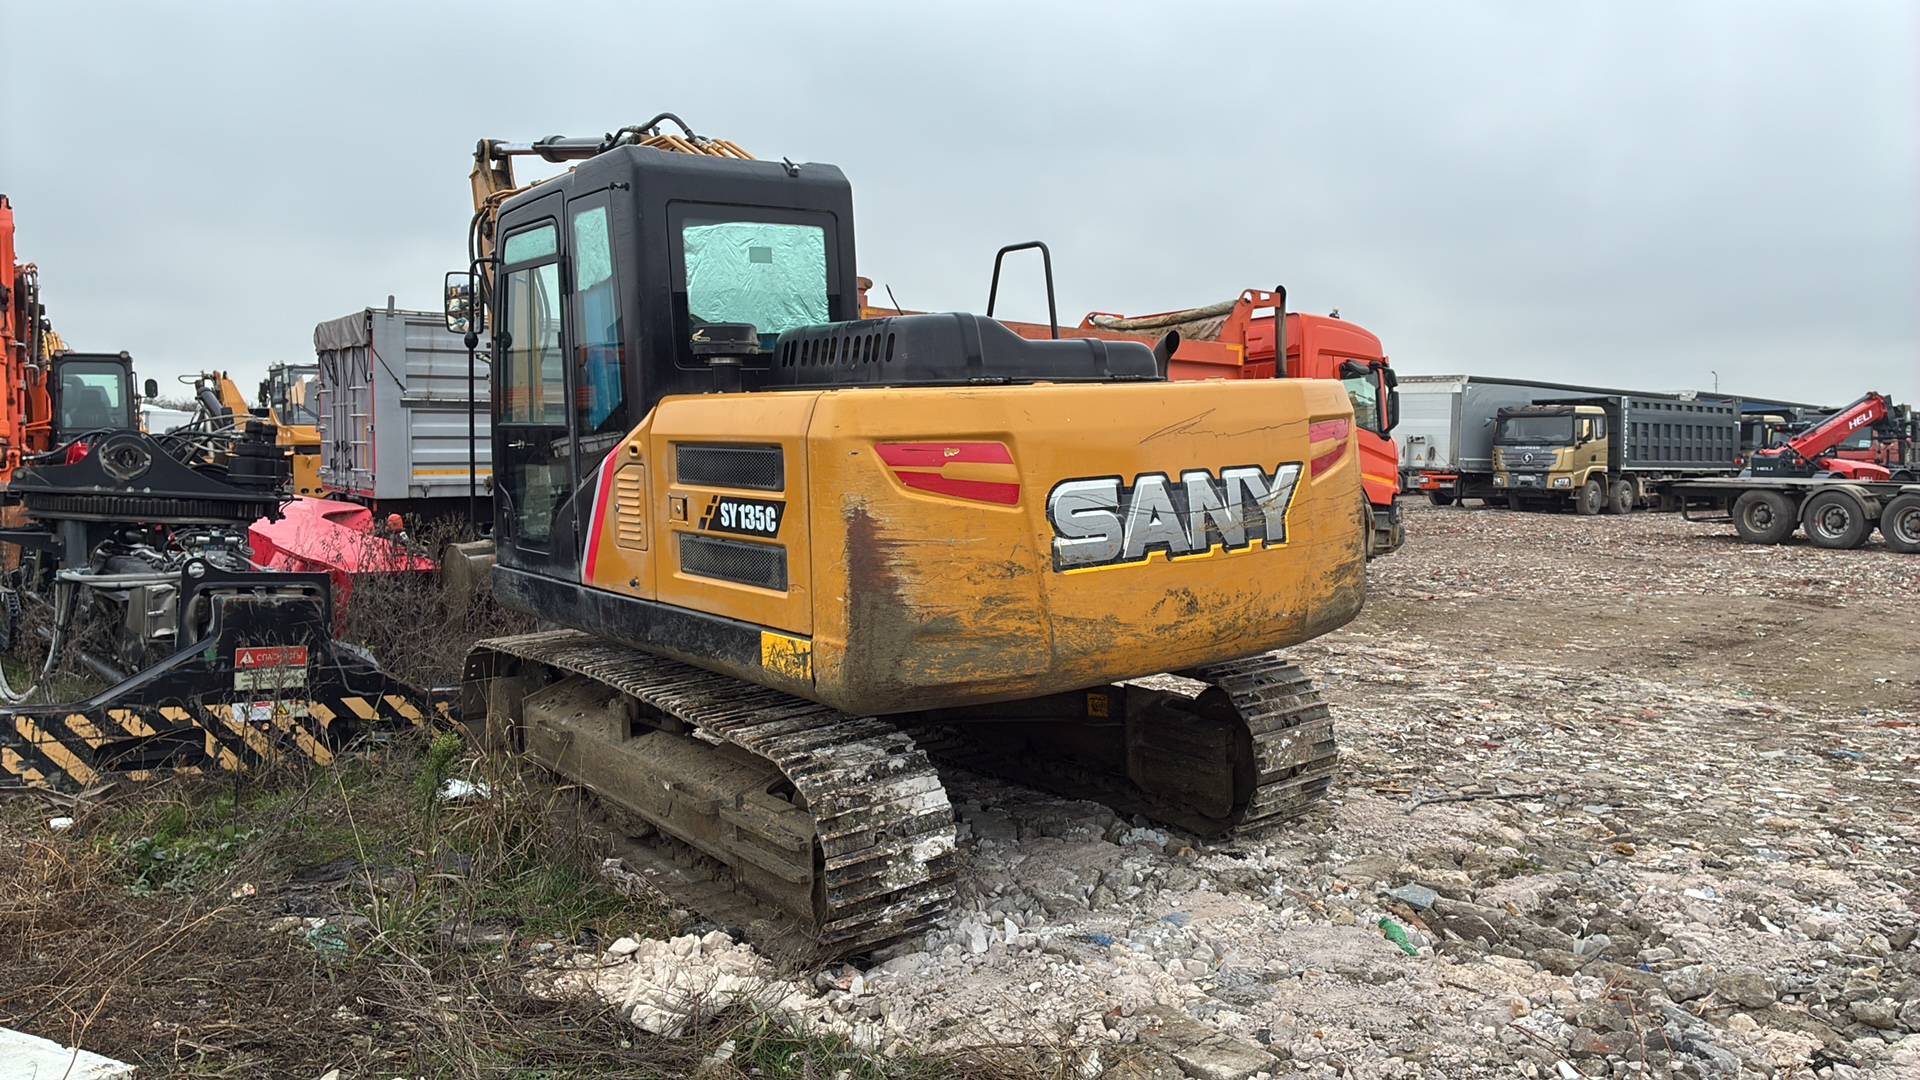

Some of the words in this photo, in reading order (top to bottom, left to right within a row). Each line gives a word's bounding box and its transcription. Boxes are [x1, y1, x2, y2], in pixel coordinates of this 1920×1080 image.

[1848, 409, 1873, 430] HELI
[720, 502, 776, 532] SY135C
[1049, 463, 1303, 569] SANY
